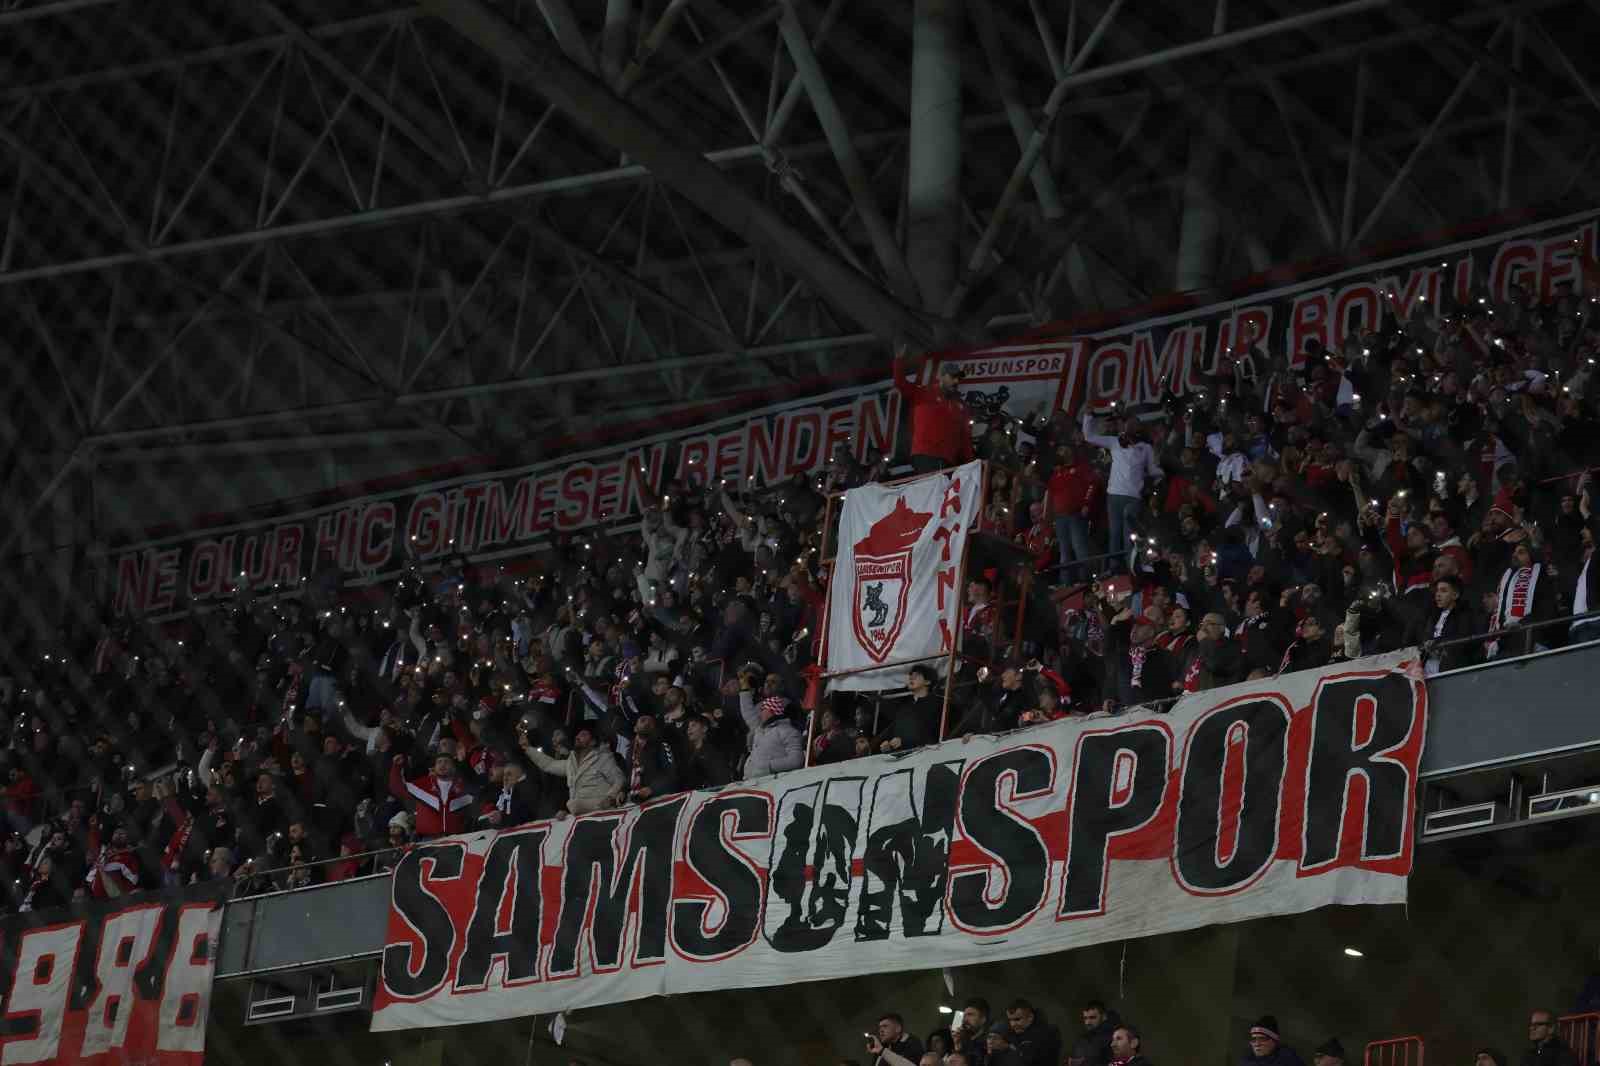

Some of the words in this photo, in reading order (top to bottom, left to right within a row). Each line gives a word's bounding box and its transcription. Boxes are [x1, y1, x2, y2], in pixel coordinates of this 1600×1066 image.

[112, 548, 182, 616] NE
[187, 525, 304, 598] OLUR
[382, 667, 1428, 1001] SAMSUNSPOR
